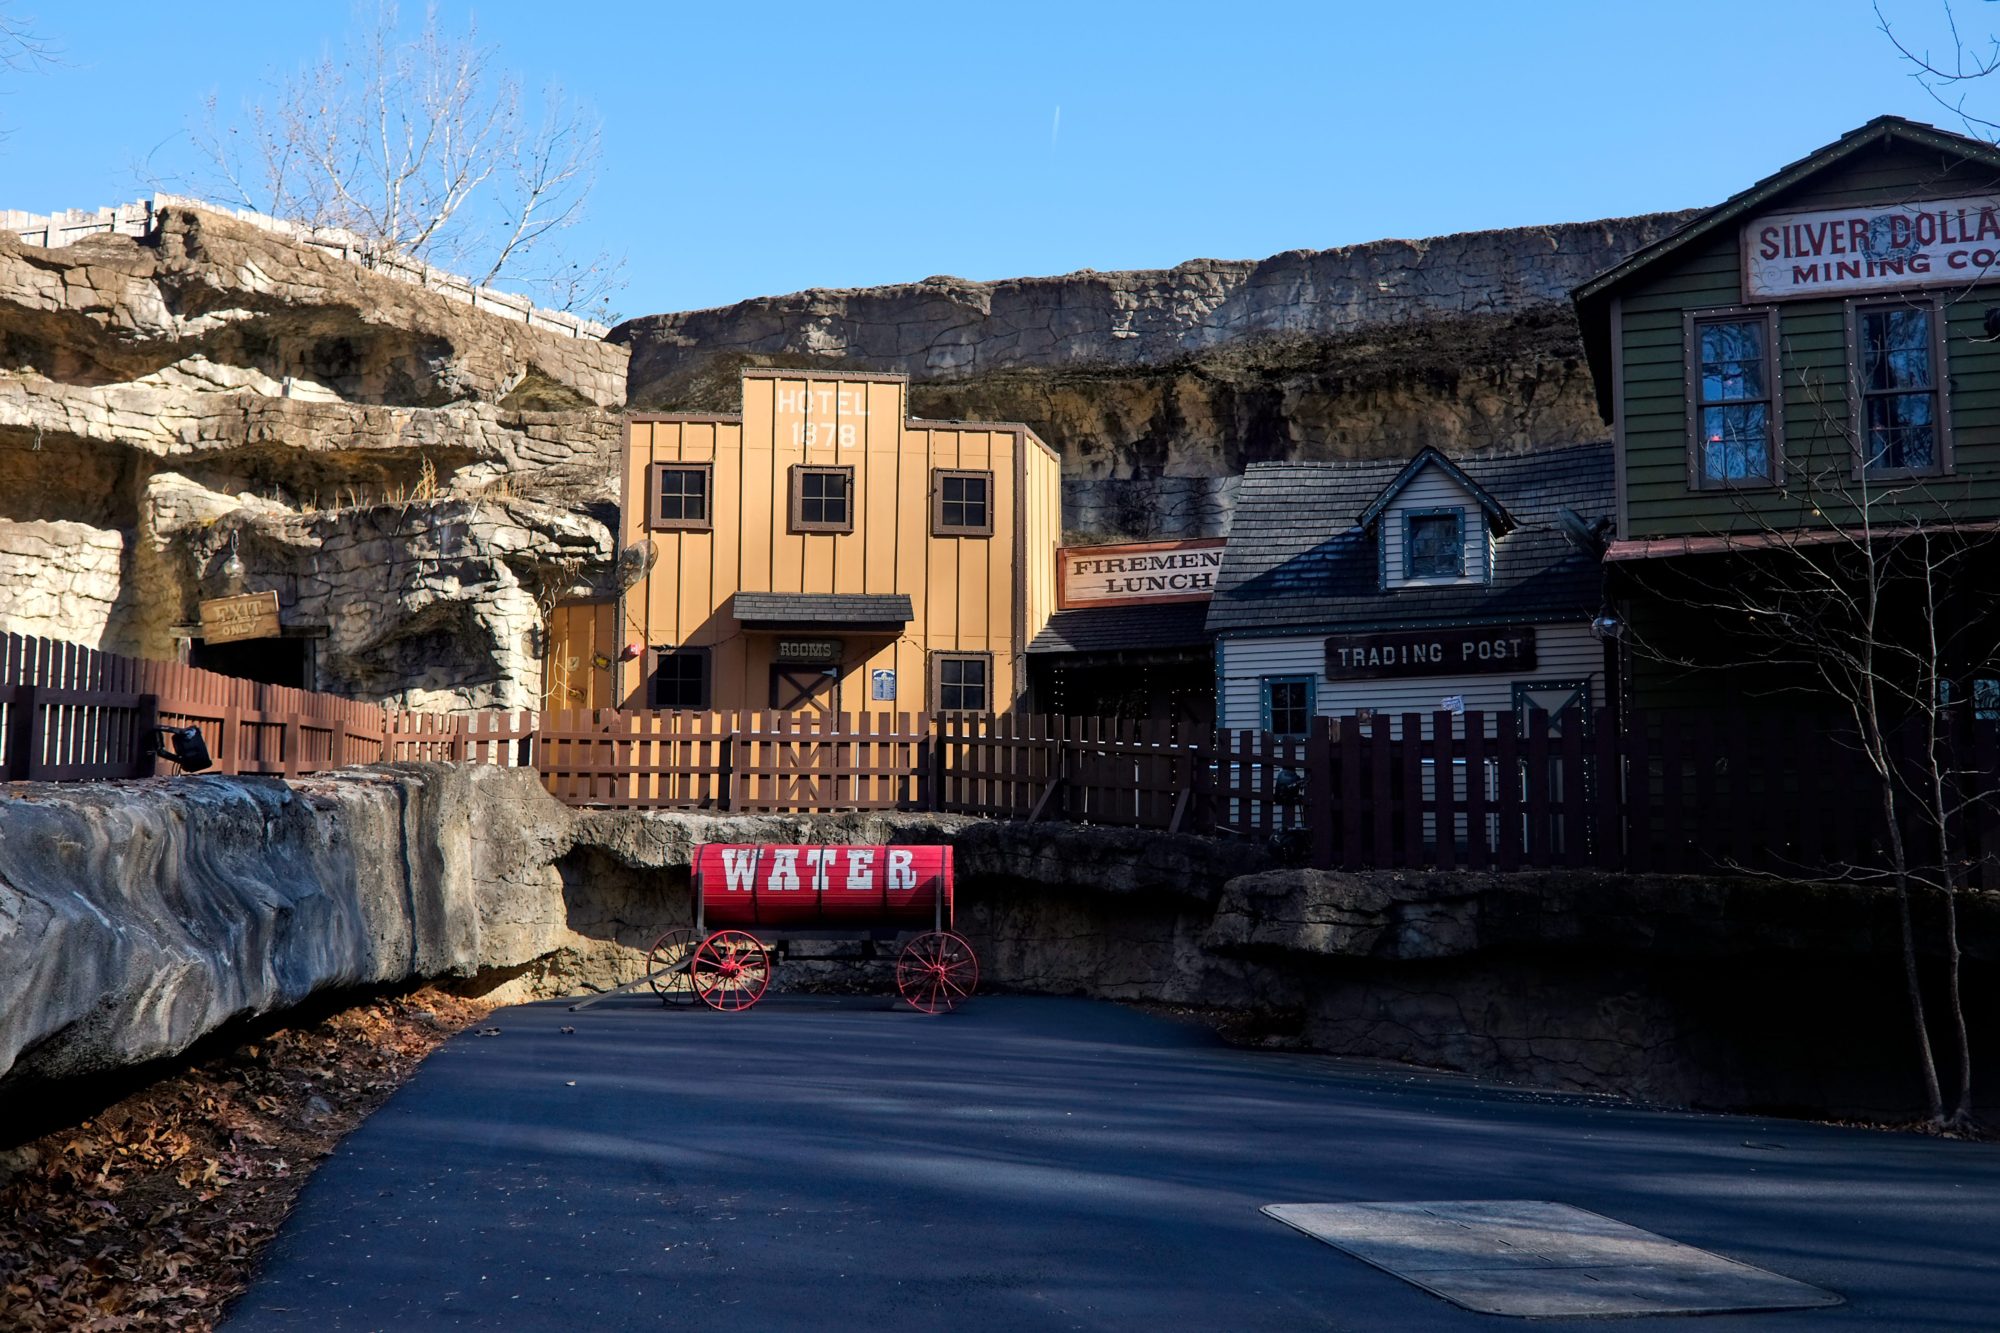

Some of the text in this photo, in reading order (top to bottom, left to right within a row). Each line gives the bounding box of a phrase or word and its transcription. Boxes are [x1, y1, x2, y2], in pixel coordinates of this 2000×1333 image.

[1760, 218, 1870, 261] SILVER
[1792, 253, 1931, 285] MINING
[778, 389, 871, 416] HOTEL
[792, 421, 856, 448] 1878
[1073, 551, 1222, 576] FIREMEN
[1105, 572, 1213, 593] LUNCH
[213, 600, 263, 622] EXIT
[222, 621, 257, 636] ONLY
[780, 642, 832, 657] ROOMS
[1338, 639, 1521, 667] TRADING POST
[721, 848, 917, 891] WATER
